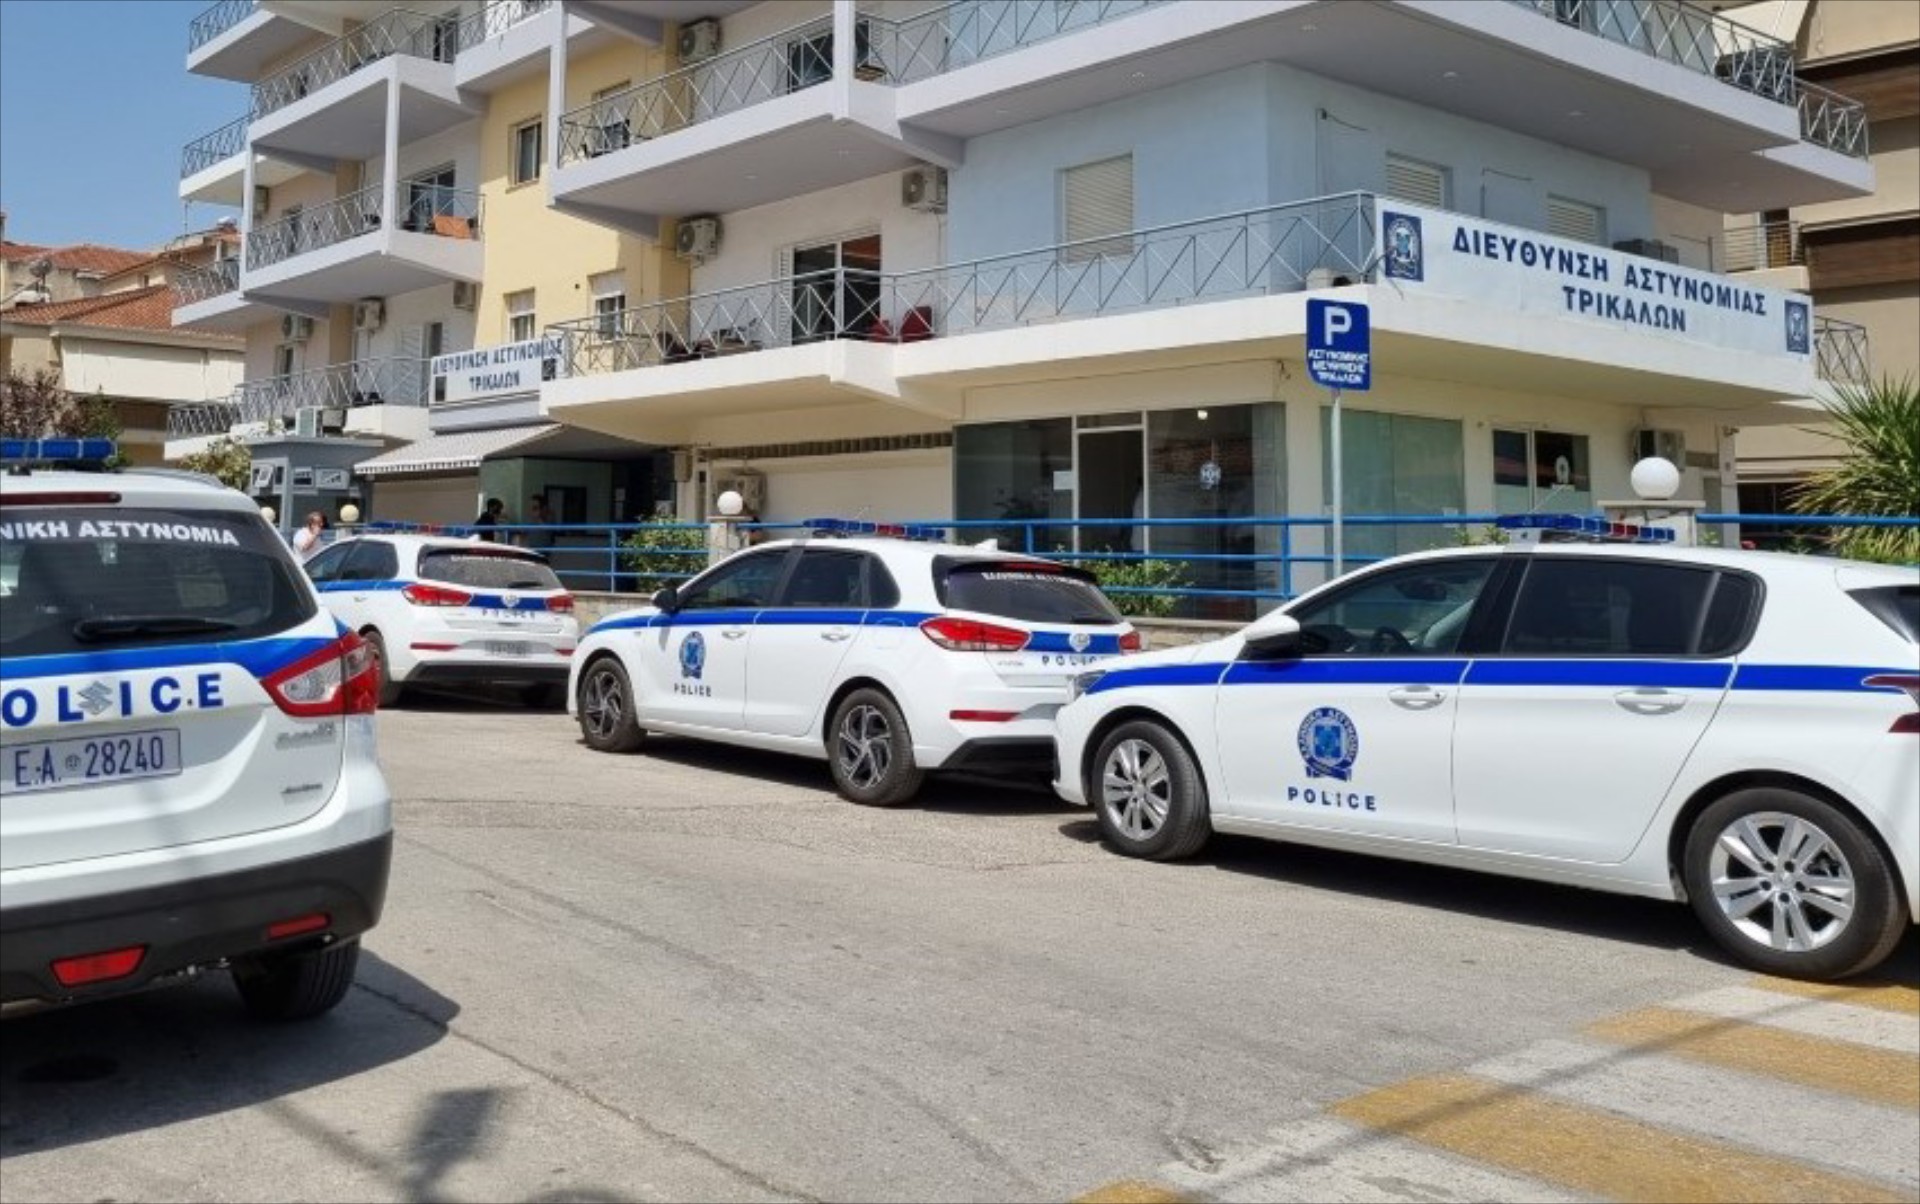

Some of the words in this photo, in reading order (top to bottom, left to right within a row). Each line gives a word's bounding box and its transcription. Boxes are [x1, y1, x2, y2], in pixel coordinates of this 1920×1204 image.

[1452, 226, 1609, 282] ΔΙΕΥΘΥΝΣΗ
[1624, 264, 1767, 316] ΑΣΤΥΝΟΜΙΑΣ
[1562, 285, 1687, 332] ΤΡΙΚΑΛΩΝ
[1324, 306, 1352, 345] P
[469, 369, 520, 391] ΤΡΙΚΑΛΩΝ
[78, 520, 240, 546] ΑΣΤΥΝΟΜΙΑ
[674, 682, 711, 697] POLICE
[85, 736, 164, 779] 28240
[1287, 786, 1377, 812] POLICE
